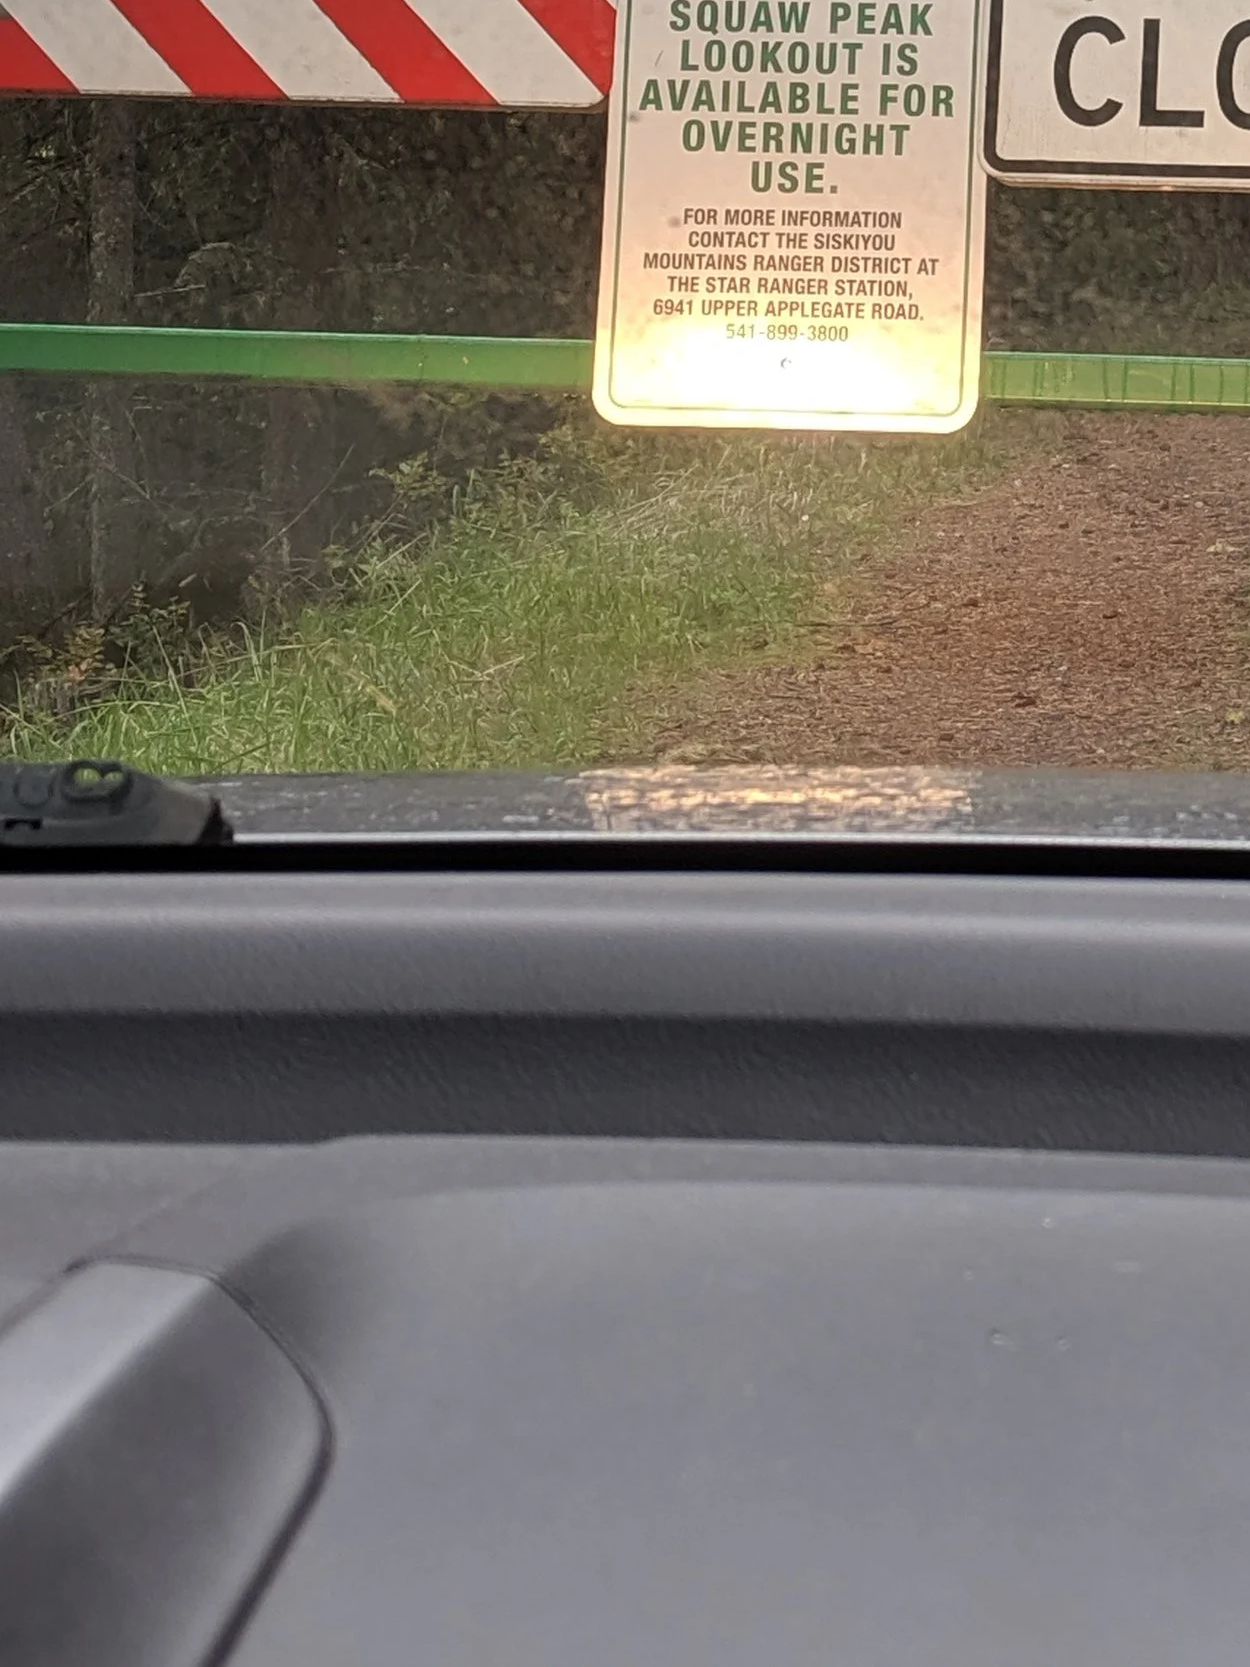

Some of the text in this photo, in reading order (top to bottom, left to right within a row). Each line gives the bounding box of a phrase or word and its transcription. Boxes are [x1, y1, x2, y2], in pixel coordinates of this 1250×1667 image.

[829, 1, 934, 36] PEAK
[680, 39, 918, 76] LOOKOUT IS
[639, 78, 954, 117] AVAILABLE FOR
[682, 119, 910, 156] OVERNIGHT
[751, 160, 838, 194] USE.
[683, 208, 902, 228] FOR MORE INFORMATION
[688, 231, 896, 251] CONTACT THE SISKIYOU
[643, 252, 939, 276] MOUNTAINS RANGER DISTRICT AT
[667, 275, 913, 301] THE STAR RANGER STATION,
[653, 299, 924, 321] 6941 UPPER APPLEGATE ROAD.
[726, 323, 849, 342] 541-899-3800
